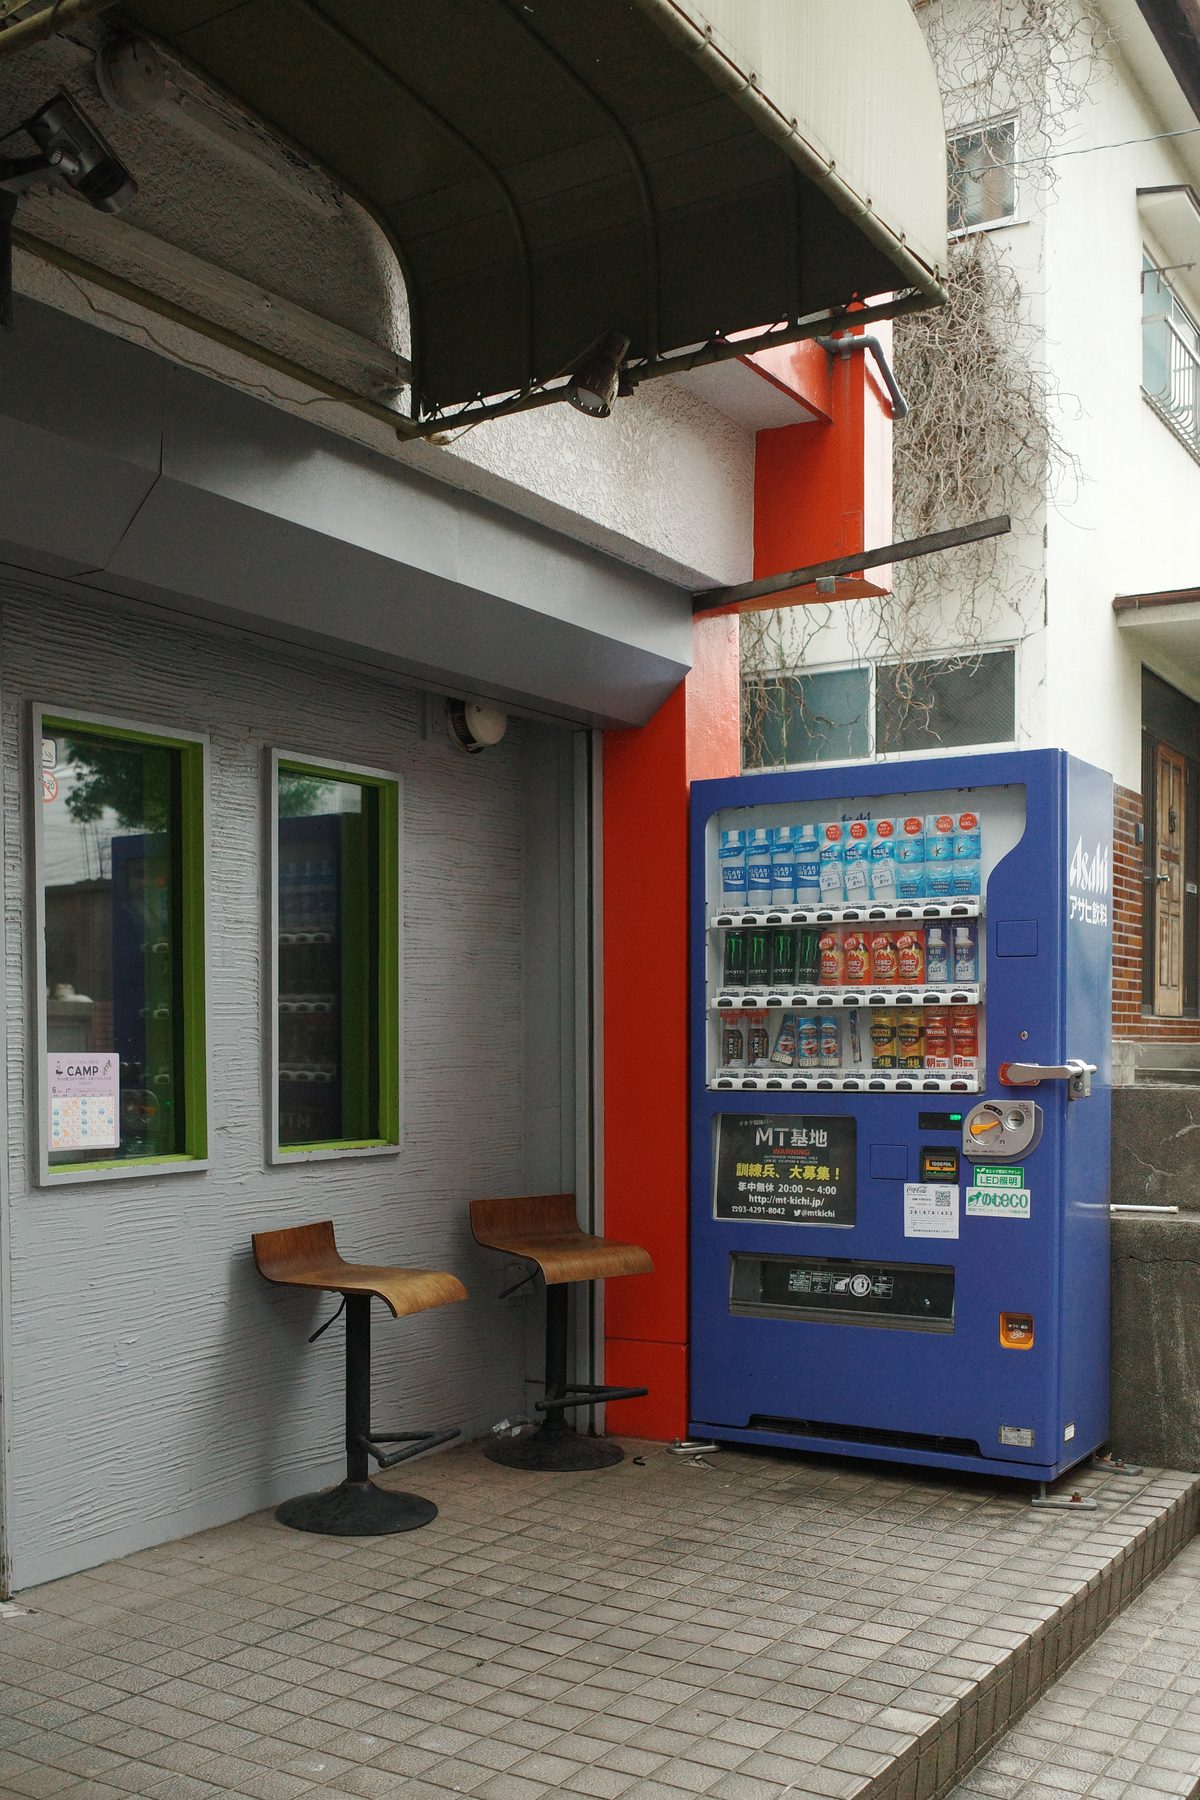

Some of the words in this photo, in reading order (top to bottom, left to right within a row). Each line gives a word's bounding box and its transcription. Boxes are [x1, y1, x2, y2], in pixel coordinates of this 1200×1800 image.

[1069, 835, 1107, 896] Asahi
[1069, 895, 1107, 927] アサヒ飲料
[67, 1066, 99, 1076] CAMP
[755, 1127, 828, 1147] MT基地
[773, 1148, 811, 1156] WARNING
[980, 1176, 1018, 1186] LED照明
[738, 1182, 774, 1192] 年中無休
[778, 1184, 803, 1193] 20:00
[817, 1186, 837, 1195] 4:00
[748, 1194, 824, 1207] http://mt-kichi.jp/
[981, 1192, 1028, 1208] のむeco
[801, 1209, 835, 1217] @mtkichi
